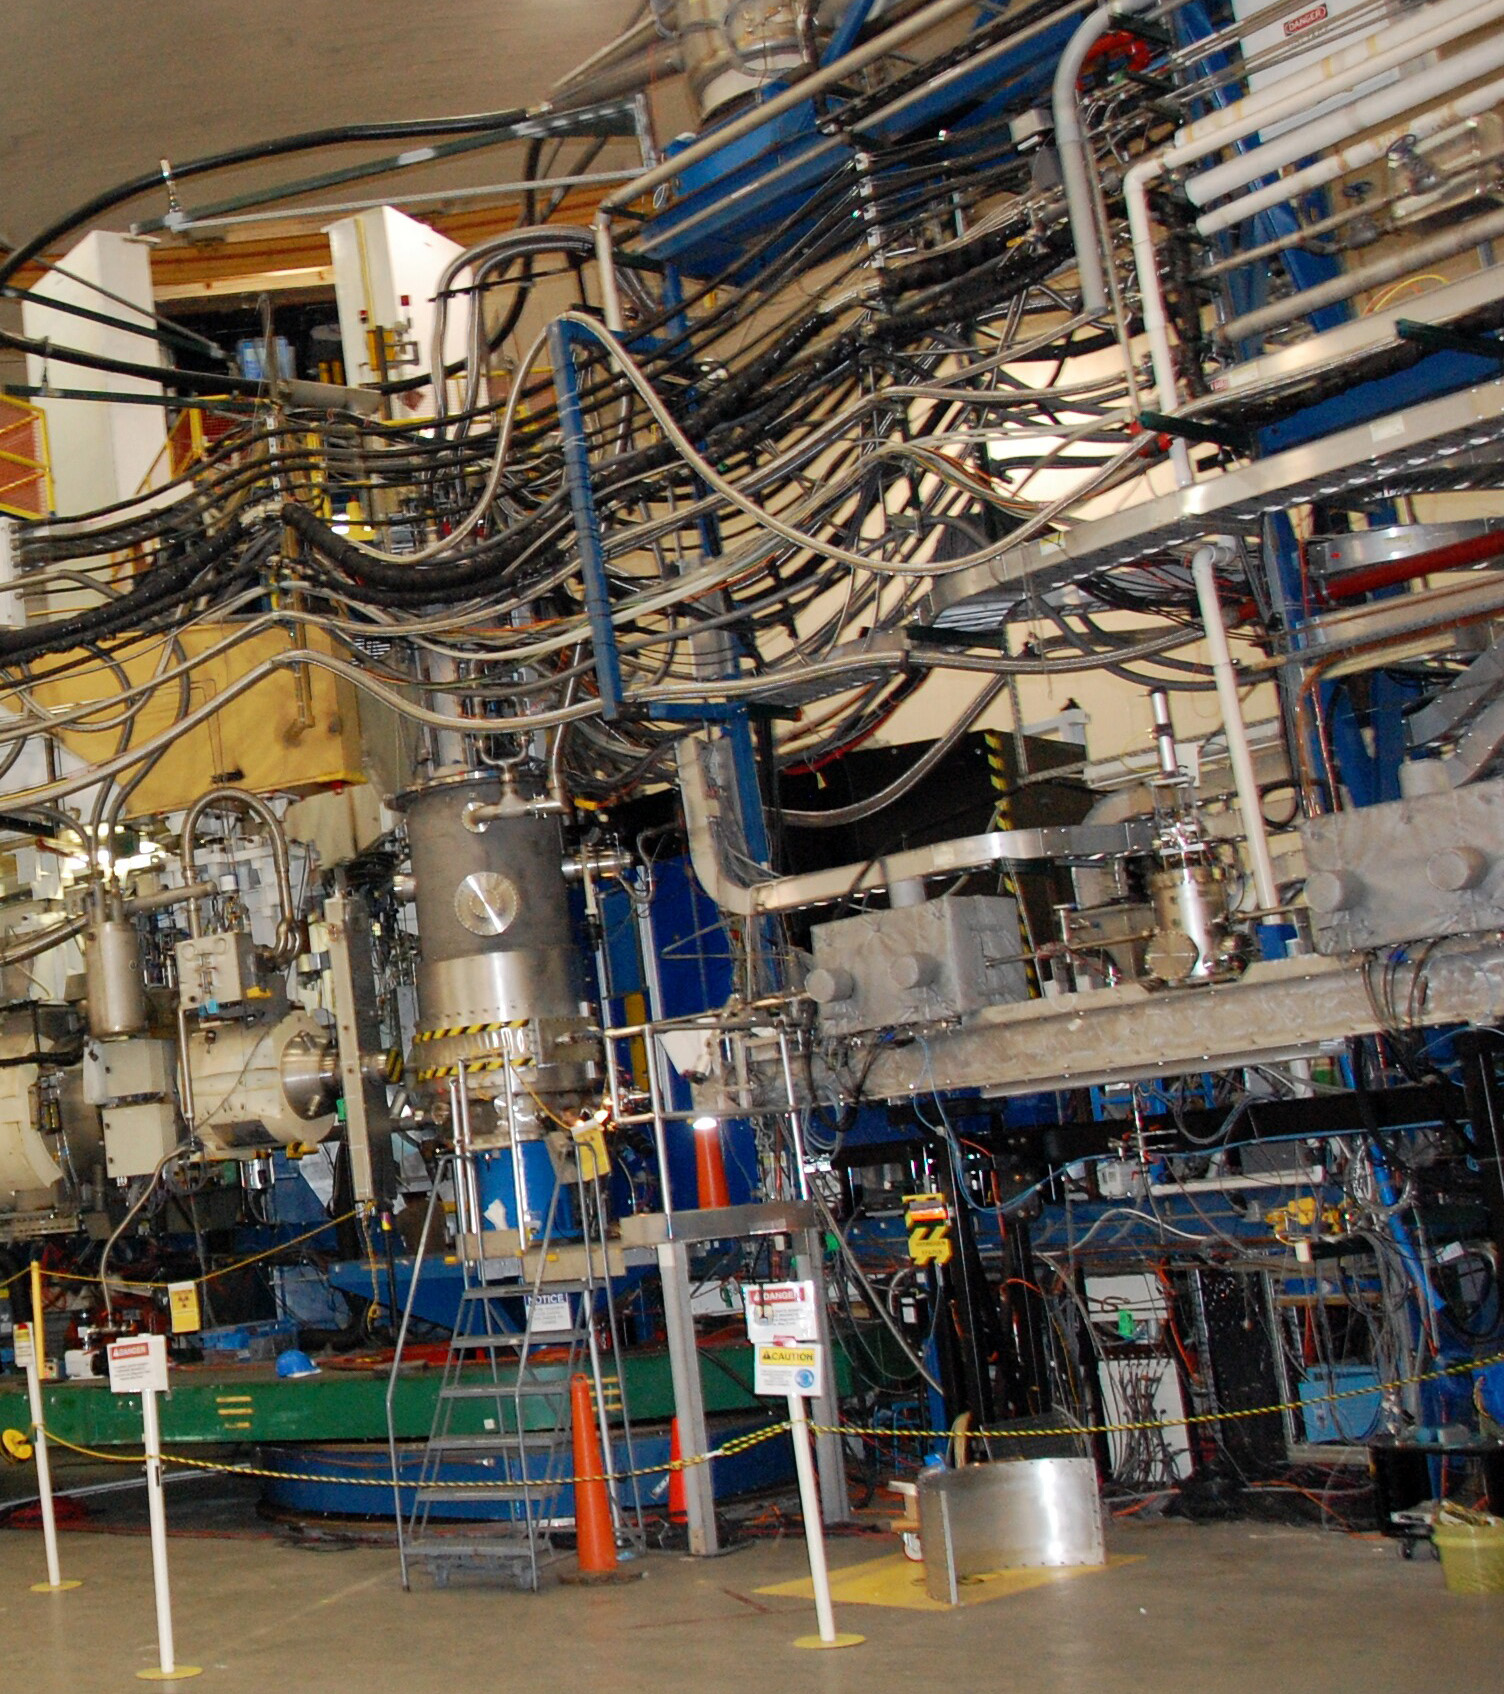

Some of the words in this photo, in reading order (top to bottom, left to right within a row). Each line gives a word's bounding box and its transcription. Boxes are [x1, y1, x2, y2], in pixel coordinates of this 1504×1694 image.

[1288, 7, 1322, 31] DANGER
[764, 1290, 800, 1300] DANGE
[772, 1352, 813, 1361] CAUTION
